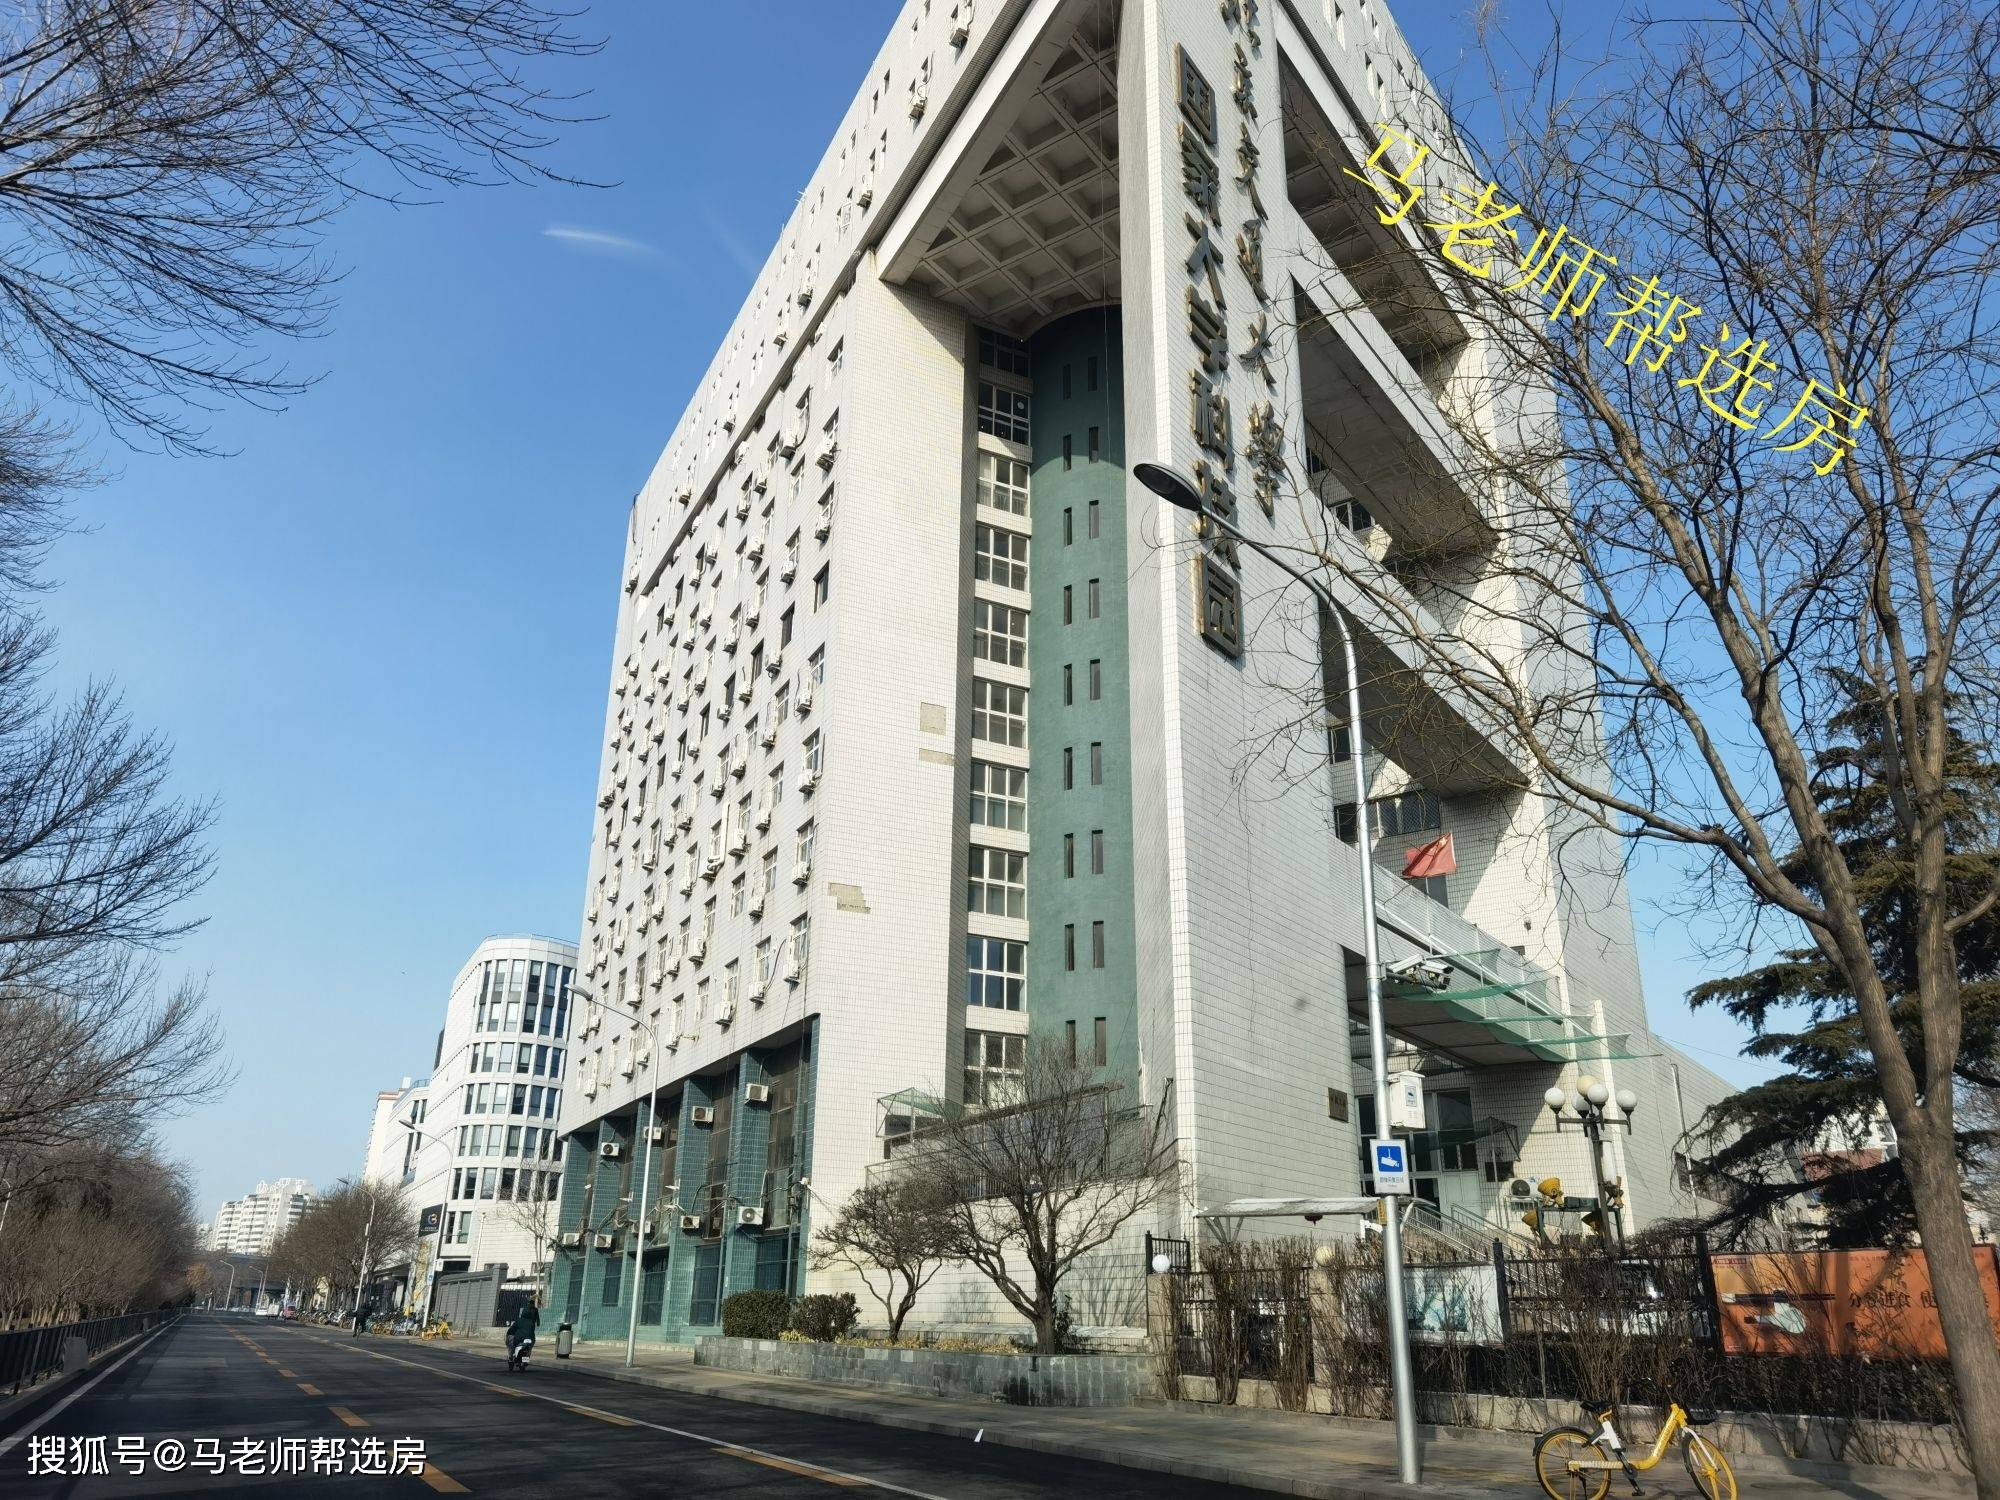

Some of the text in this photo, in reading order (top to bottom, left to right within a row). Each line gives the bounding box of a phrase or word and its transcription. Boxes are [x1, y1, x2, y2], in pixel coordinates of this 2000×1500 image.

[1172, 42, 1243, 661] 国家大学科技园
